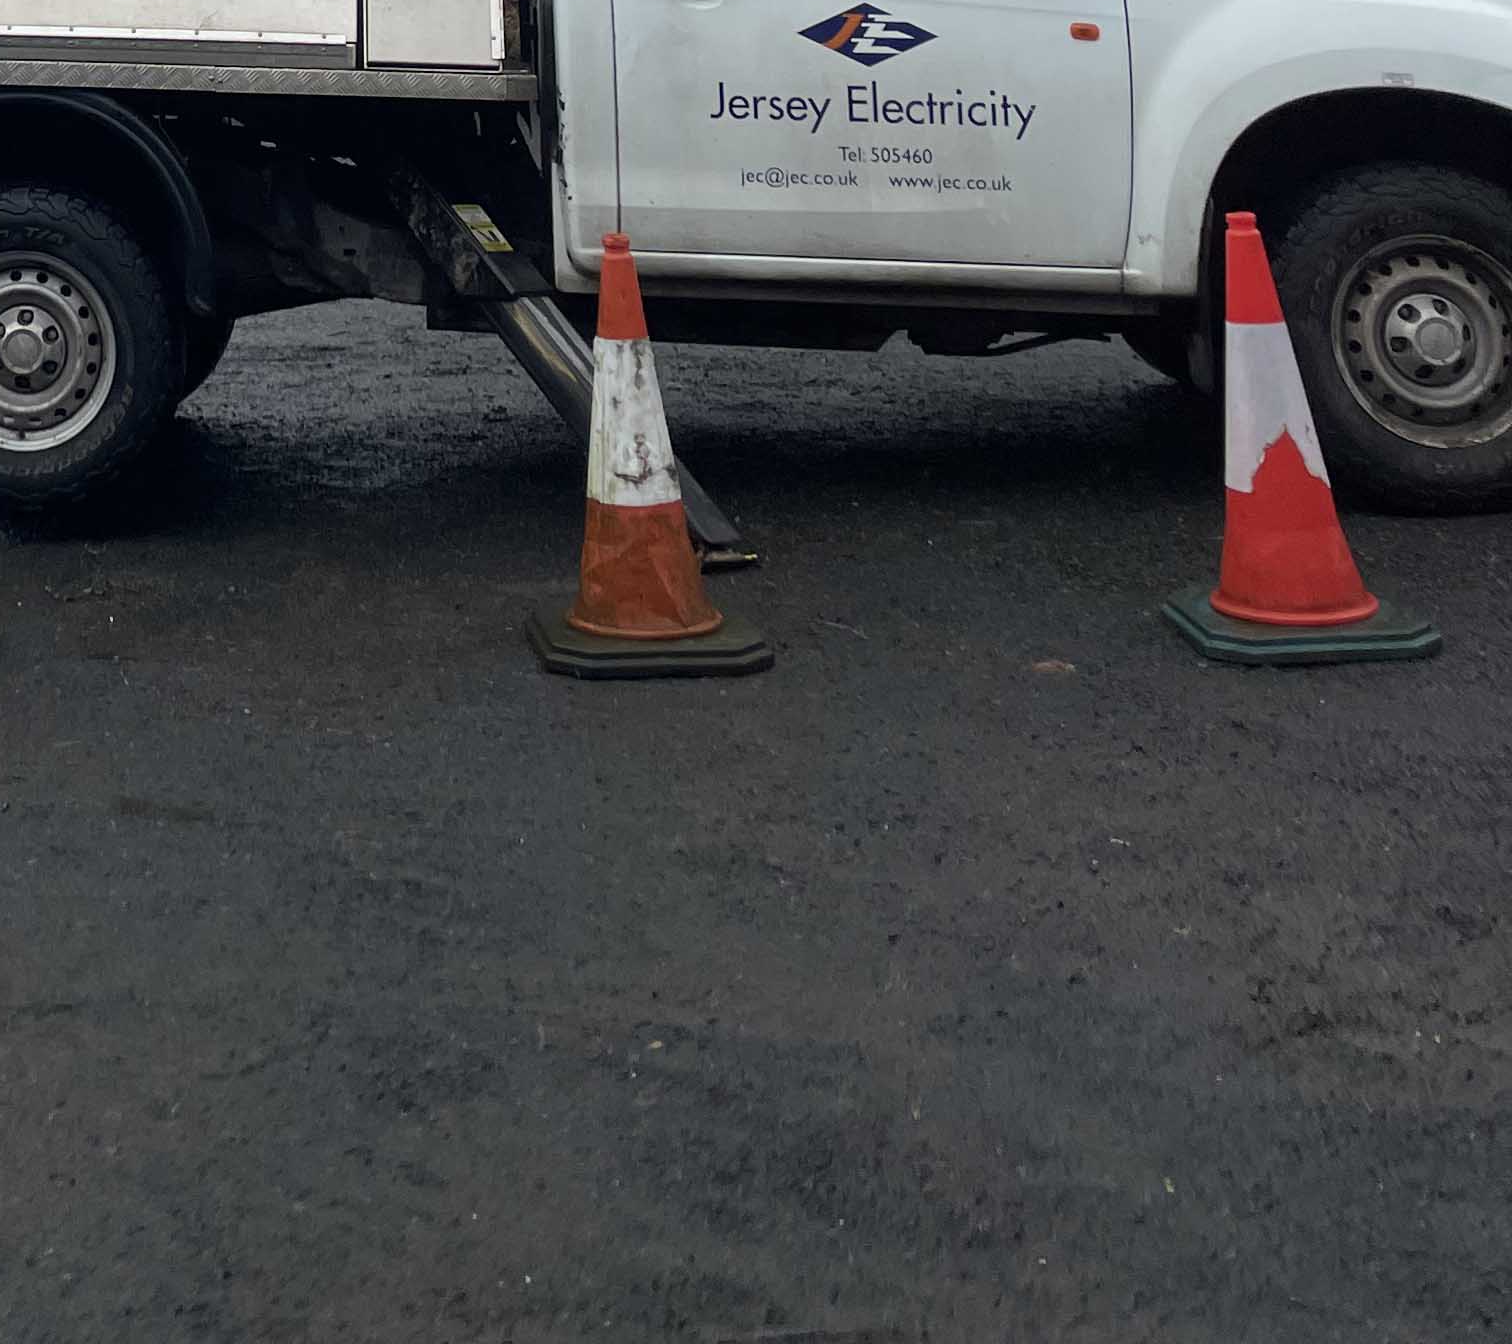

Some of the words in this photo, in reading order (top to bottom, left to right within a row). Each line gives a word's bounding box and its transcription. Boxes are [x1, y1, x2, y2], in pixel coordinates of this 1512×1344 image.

[710, 81, 831, 134] Jersey
[846, 80, 1037, 140] Electricity
[838, 146, 867, 163] Tel:
[870, 147, 934, 165] 505460
[740, 166, 859, 189] jec@jec.co.uk
[889, 174, 1013, 193] www.jec.co.uk
